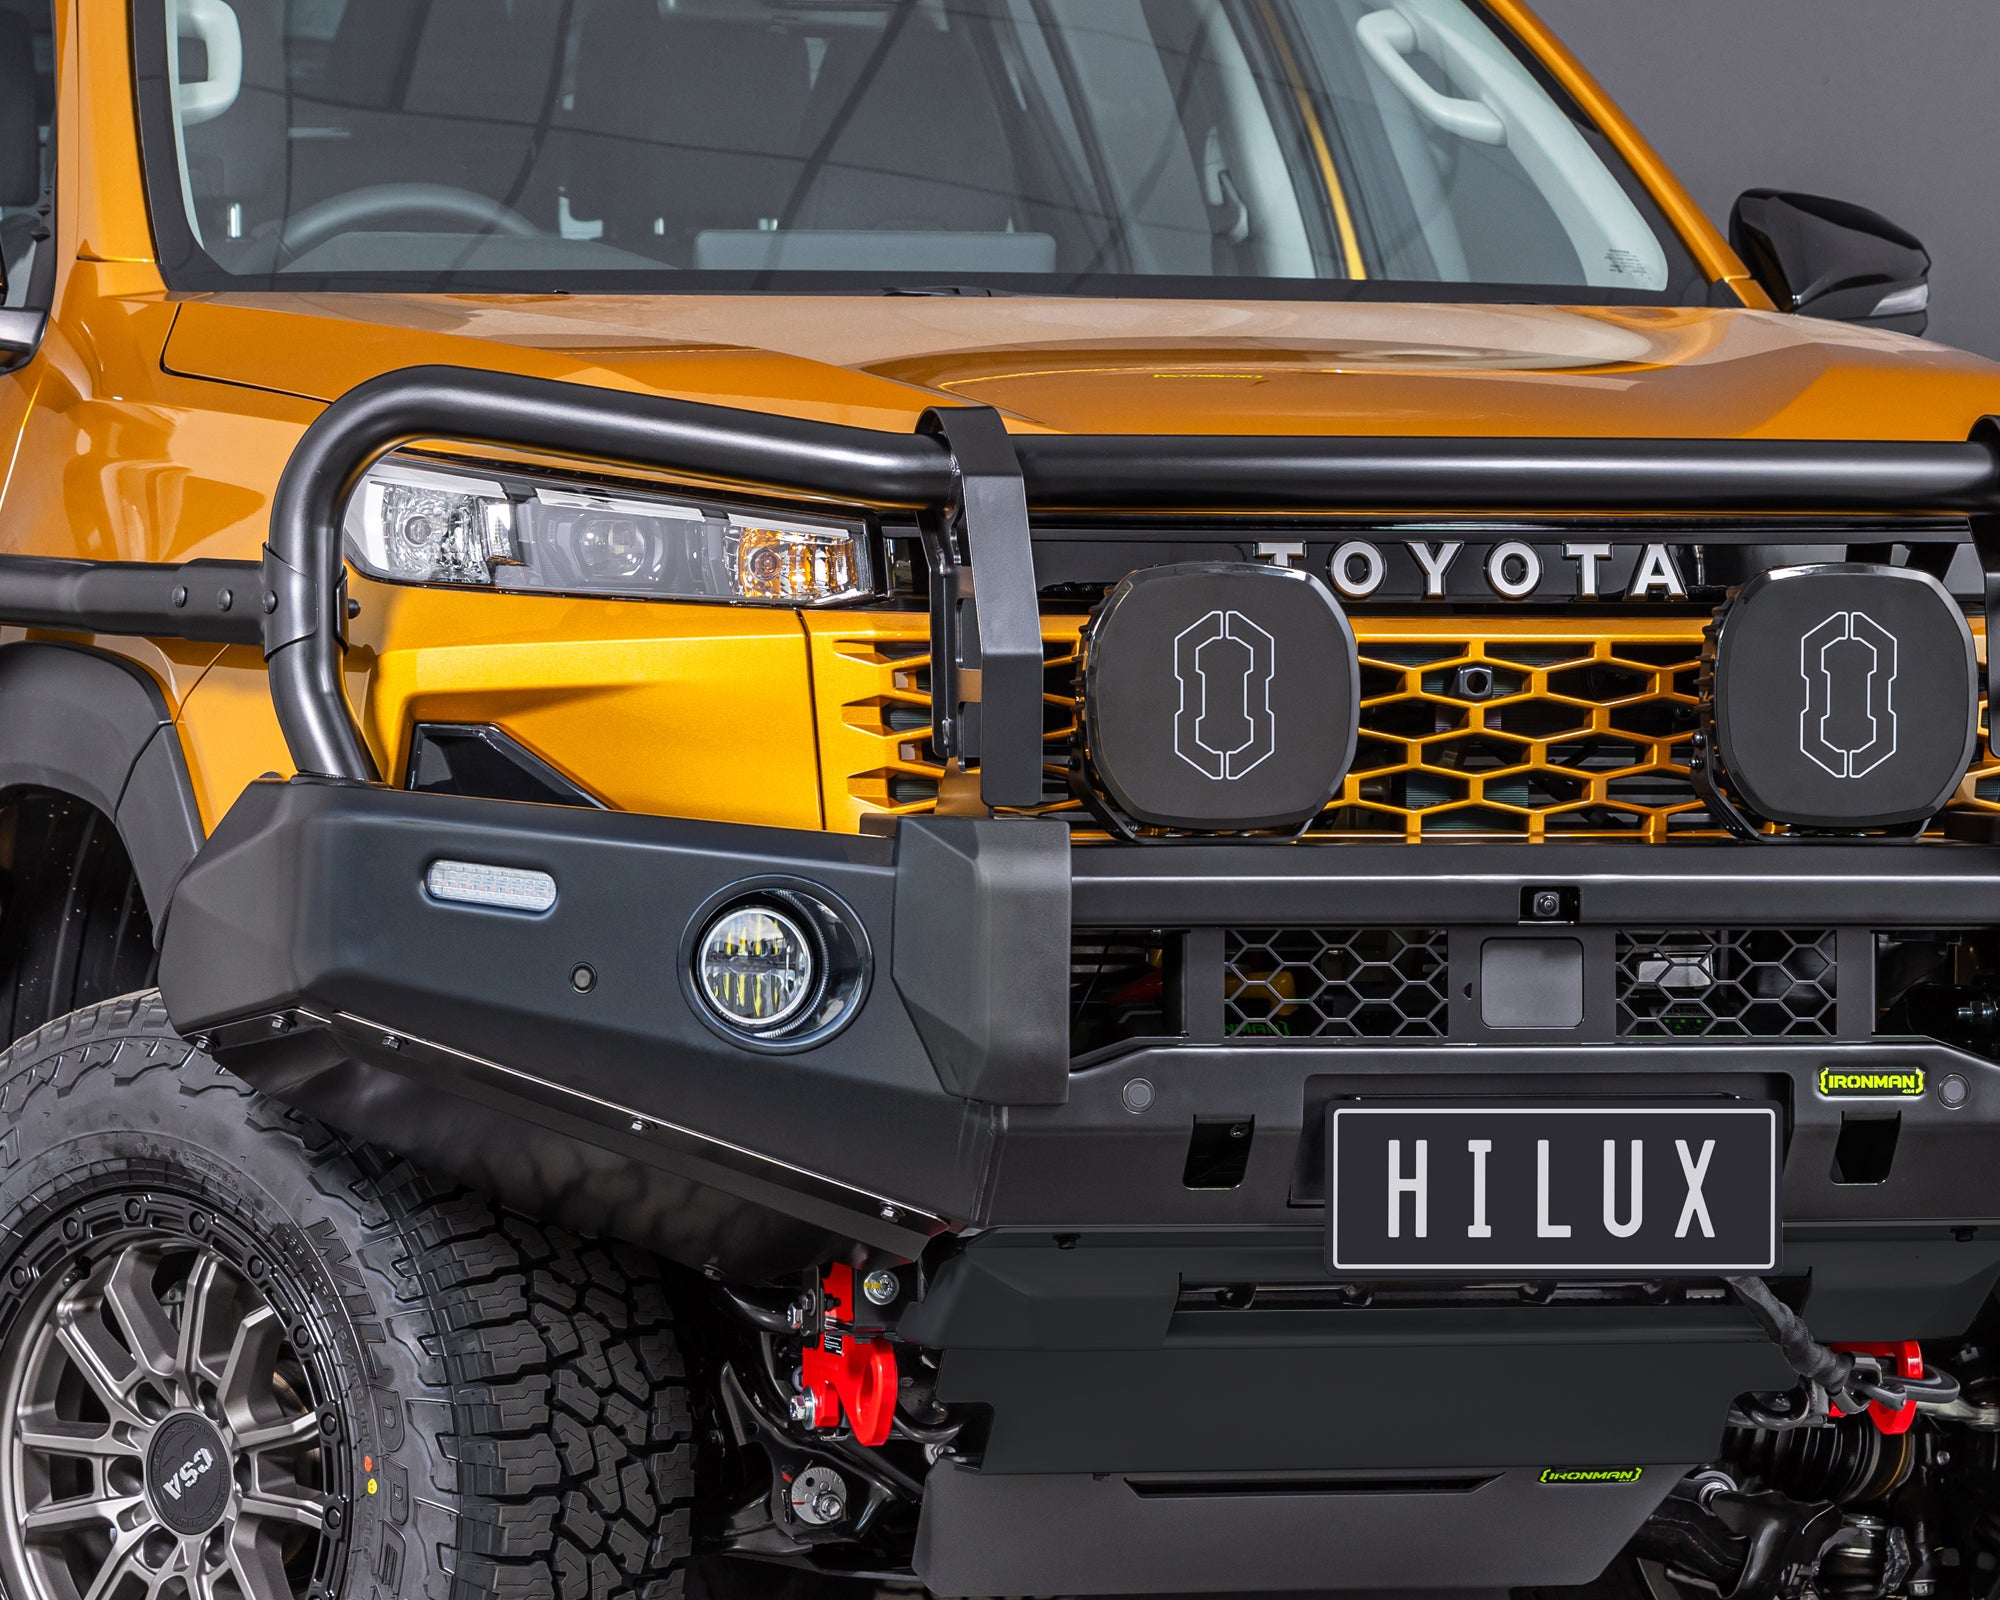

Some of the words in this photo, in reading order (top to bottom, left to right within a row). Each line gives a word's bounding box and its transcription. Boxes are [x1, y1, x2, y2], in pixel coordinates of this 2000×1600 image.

[1257, 541, 1685, 597] TOYOTA
[1828, 1074, 1916, 1089] IRONMAN
[1387, 1139, 1716, 1238] HILUX
[303, 1216, 409, 1600] WILDPE
[161, 1447, 214, 1501] CSA
[1548, 1470, 1634, 1480] IRONMAN
